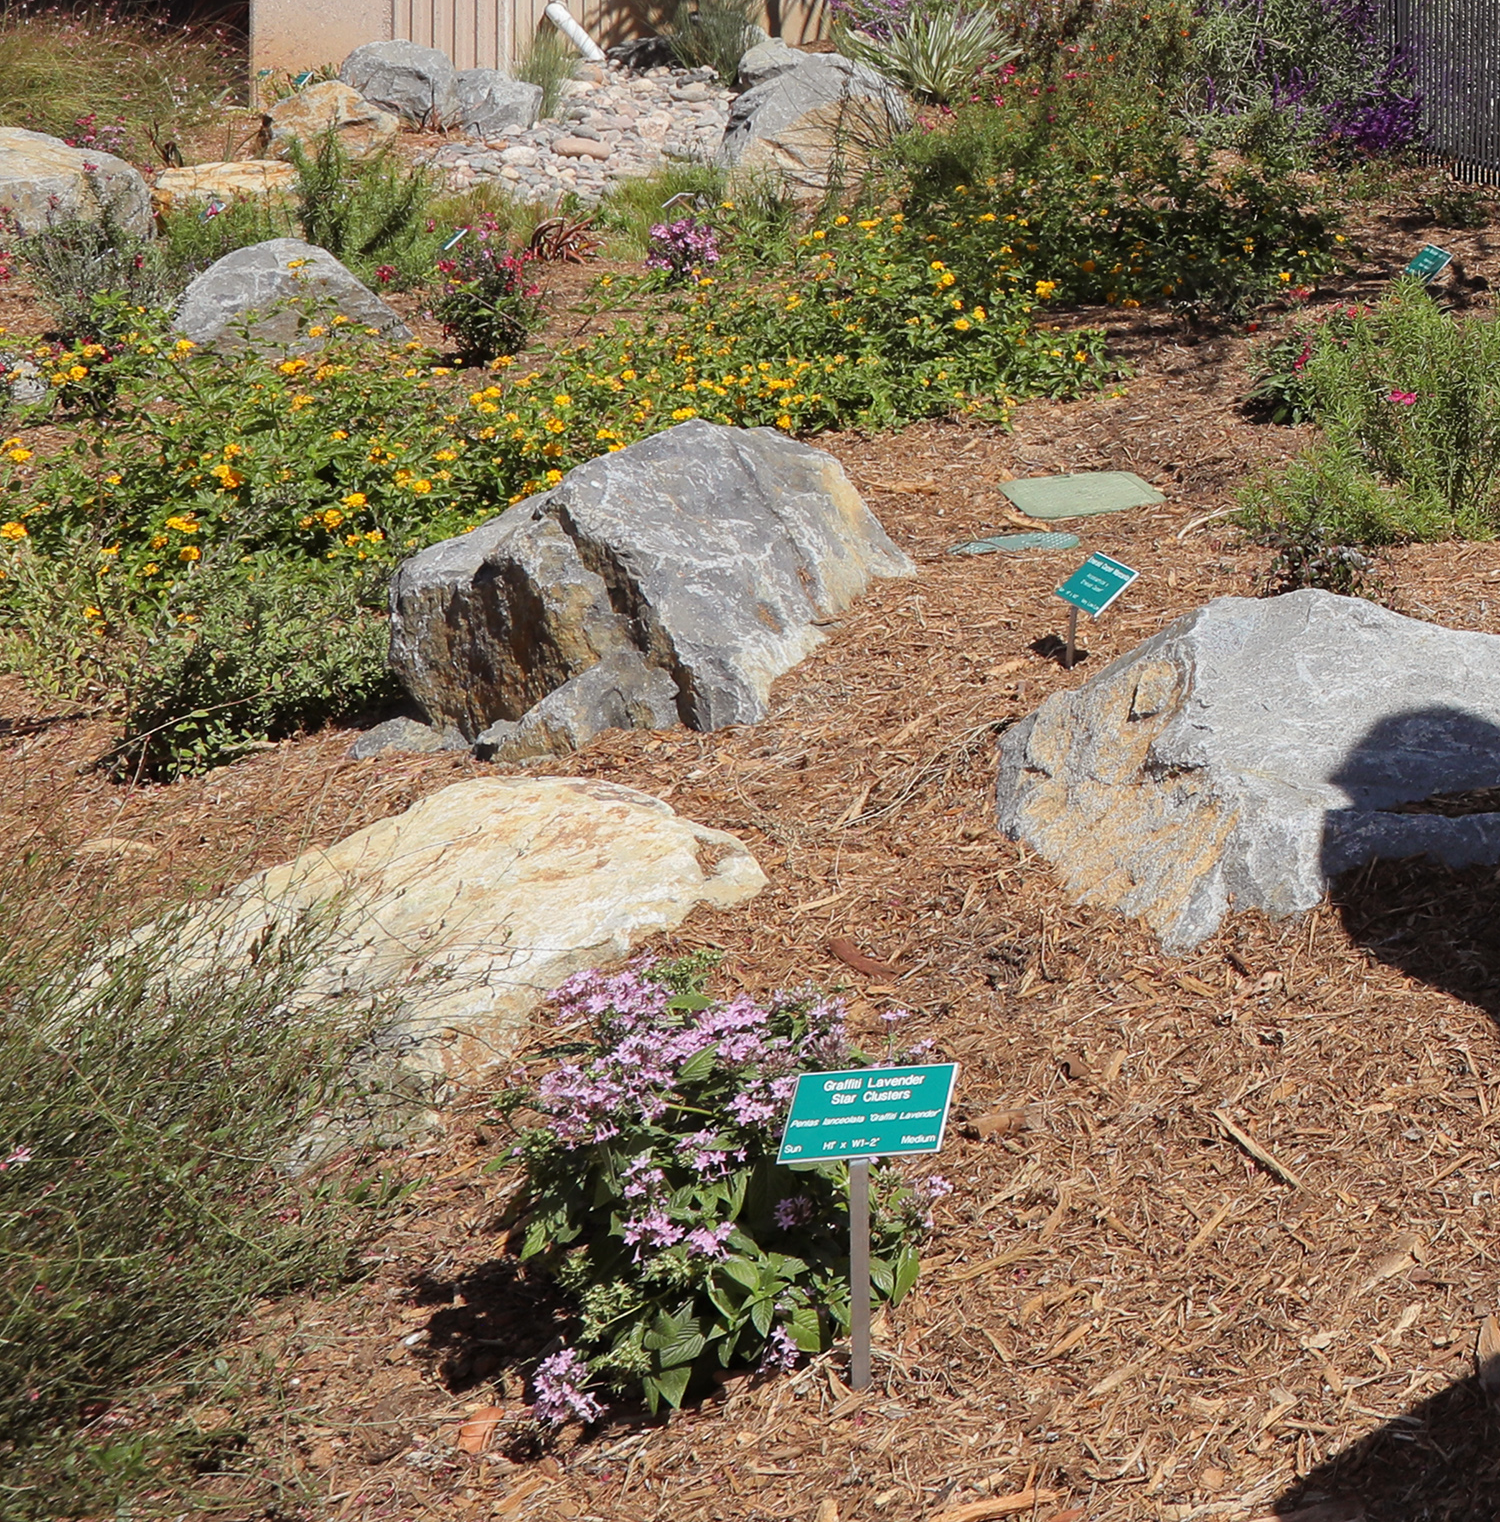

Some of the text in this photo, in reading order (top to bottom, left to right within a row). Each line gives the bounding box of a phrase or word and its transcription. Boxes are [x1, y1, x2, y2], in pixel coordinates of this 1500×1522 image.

[823, 1074, 925, 1092] Graffiti Lavender
[831, 1089, 911, 1105] Star Clusters
[790, 1119, 820, 1128] Pentas
[784, 1144, 802, 1154] Sun
[900, 1134, 936, 1144] Medium
